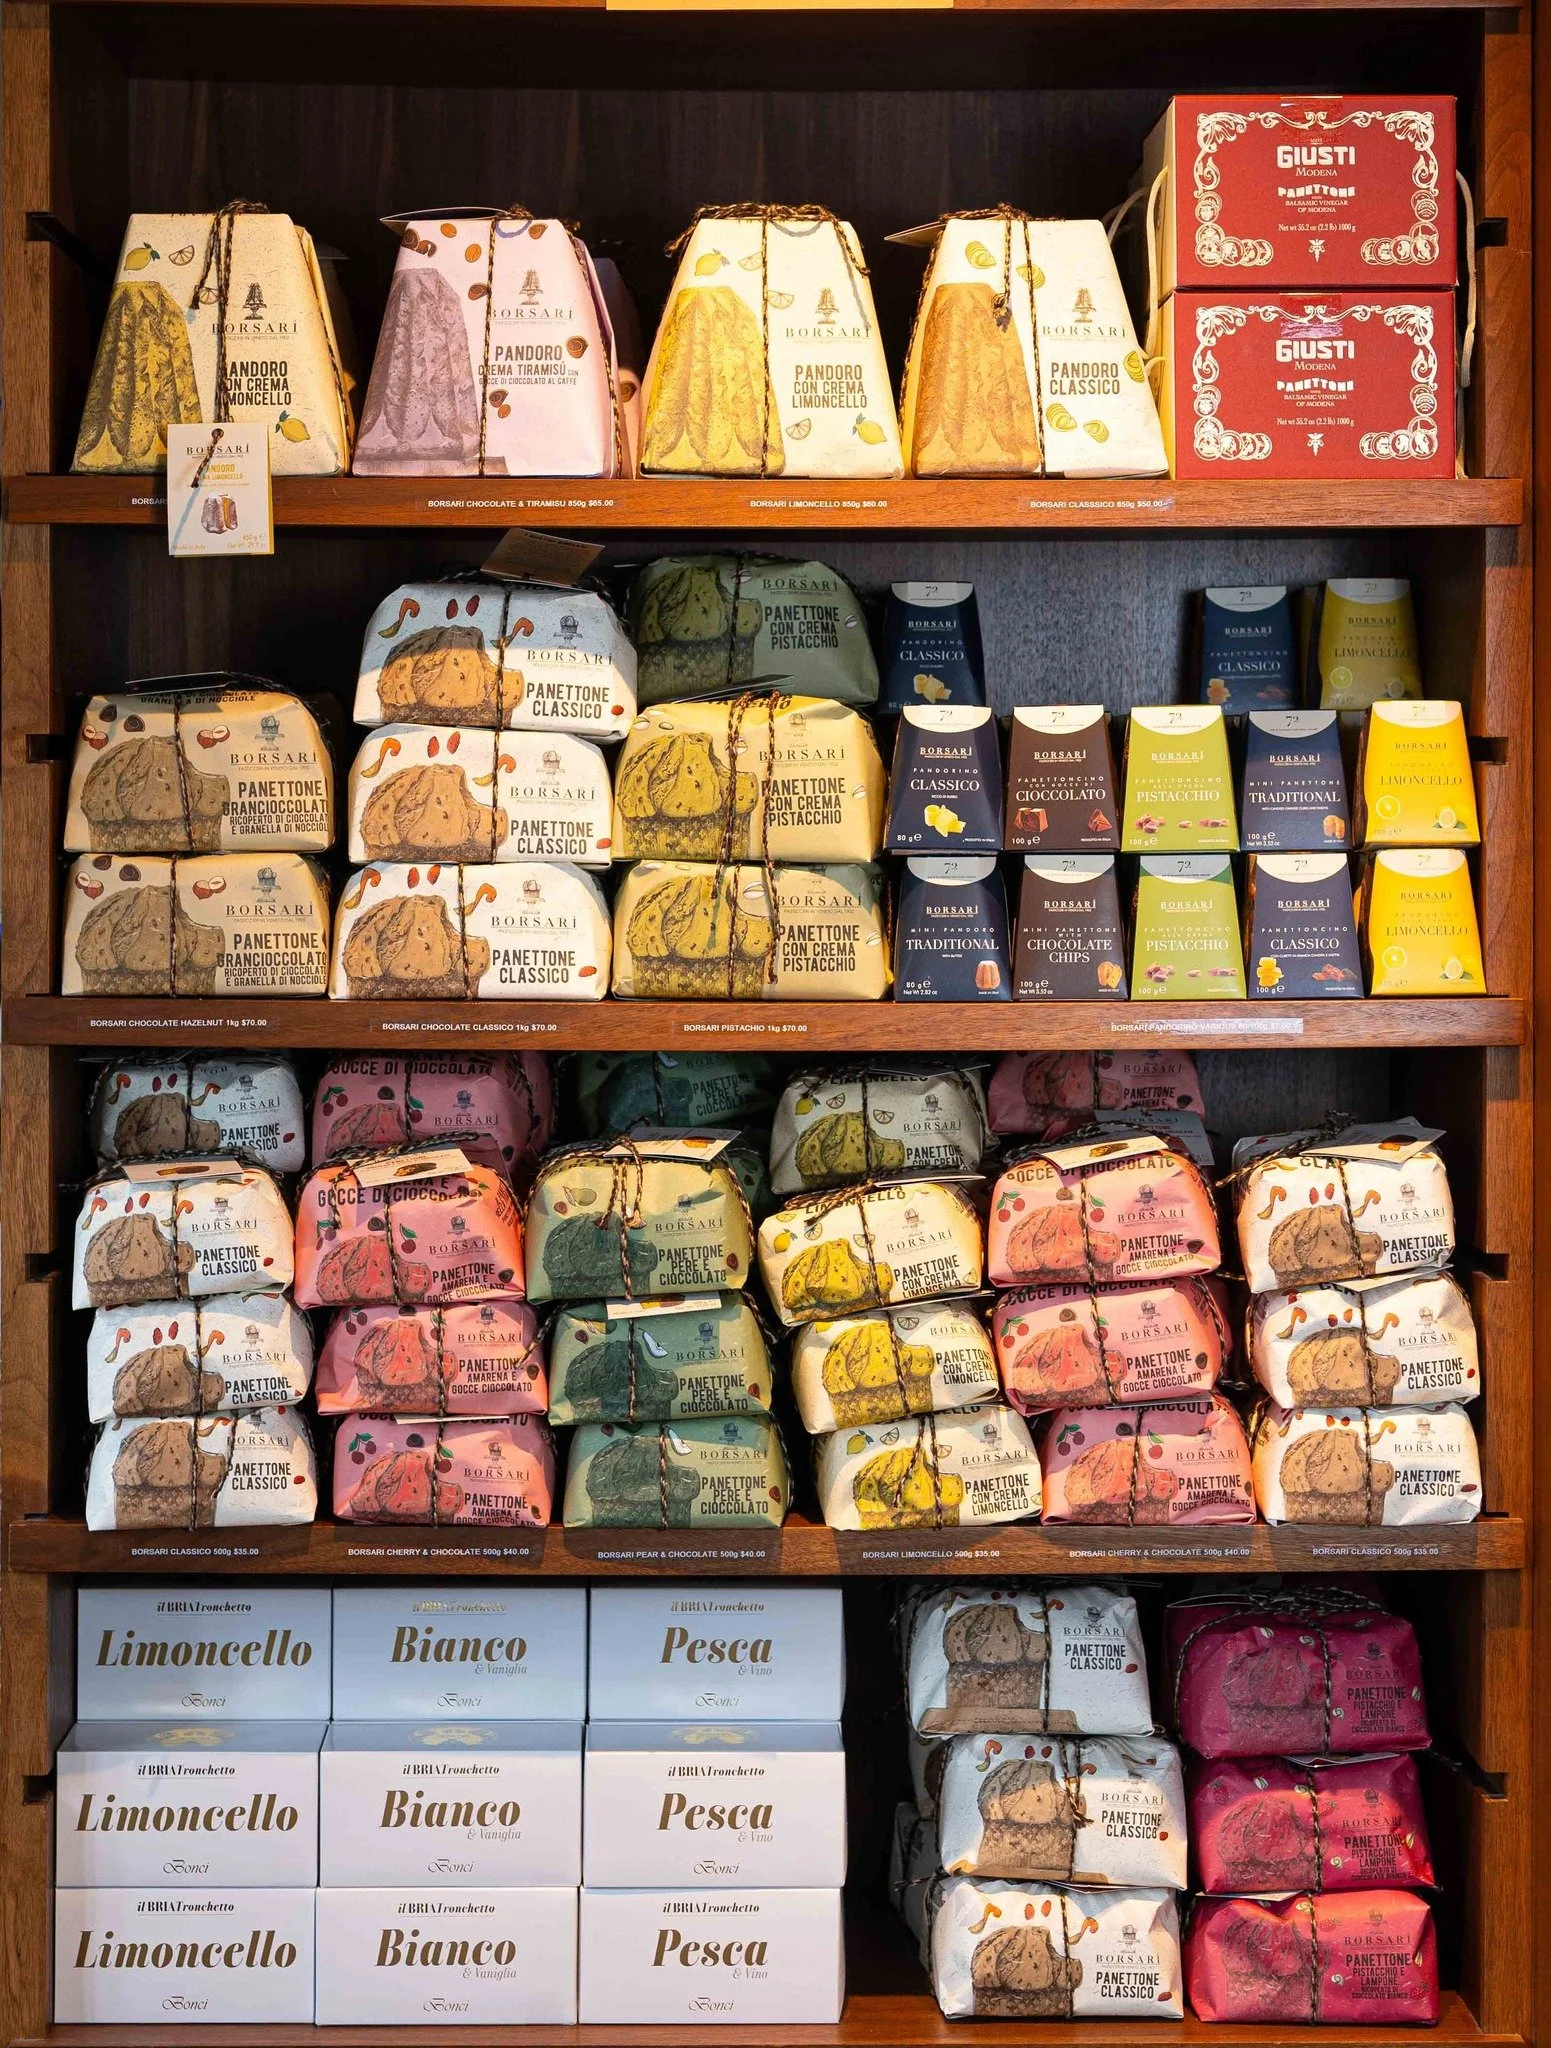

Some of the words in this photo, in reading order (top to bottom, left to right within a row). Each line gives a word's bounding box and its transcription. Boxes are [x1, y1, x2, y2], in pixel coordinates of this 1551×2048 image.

[1277, 145, 1355, 168] GIUSTI
[1278, 183, 1355, 198] PANETTONE
[1338, 223, 1351, 231] 1000
[495, 345, 563, 361] PANDORO
[1275, 339, 1355, 362] GIUSTI
[795, 364, 862, 381] PANDORO
[1051, 362, 1119, 378] PANDORO
[508, 377, 546, 385] CIOCCOLATO
[793, 381, 818, 395] CON
[823, 381, 864, 394] CREMA
[1050, 379, 1120, 395] CLASSICO
[1276, 378, 1355, 392] PANETTONE
[792, 394, 868, 409] LIMONCELLO
[428, 500, 464, 508] BORSARI
[466, 500, 516, 508] CHOCOLATE
[518, 500, 524, 508] &
[526, 500, 566, 508] TIRAMISU
[568, 500, 586, 508] 850g
[588, 500, 614, 508] $65.00
[750, 500, 787, 508] BORSARI
[789, 500, 840, 508] LIMONCELLO
[842, 500, 861, 508] 850g
[862, 500, 888, 508] $60.00
[764, 606, 840, 622] PANETTONE
[770, 622, 794, 635] CON
[799, 621, 837, 634] CREMA
[771, 635, 839, 650] PISTACCHIO
[526, 683, 610, 702] PANETTONE
[533, 700, 602, 719] CLASSICO
[910, 777, 980, 792] CLASSICO
[1016, 788, 1106, 802] CIOCCOLATO
[1136, 789, 1221, 803] PISTACCHIO
[1249, 791, 1341, 804] TRADITIONAL
[511, 820, 594, 837] PANETTONE
[517, 838, 588, 855] CLASSICO
[778, 925, 860, 942] PANETTONE
[233, 932, 319, 951] PANETTONE
[906, 938, 999, 951] TRADITIONAL
[1027, 938, 1112, 951] CHOCOLATE
[1146, 938, 1229, 951] PISTACCHIO
[1270, 937, 1340, 950] CLASSICO
[782, 943, 807, 957] CON
[812, 942, 856, 957] CREMA
[1049, 951, 1090, 963] CHIPS
[493, 949, 576, 966] PANETTONE
[783, 956, 856, 972] PISTACCHIO
[500, 967, 570, 984] CLASSICO
[90, 1019, 127, 1027] BORSARI
[129, 1019, 178, 1027] CHOCOLATE
[181, 1019, 223, 1027] HAZELNUT
[226, 1019, 239, 1027] 1kg
[241, 1019, 267, 1027] $70.00
[382, 1023, 419, 1031] BORSARI
[421, 1023, 470, 1031] CHOCOLATE
[472, 1023, 514, 1031] CLASSICO
[515, 1023, 529, 1031] 1kg
[531, 1023, 557, 1031] $70.00
[684, 1024, 720, 1032] BORSARI
[721, 1024, 765, 1032] PISTACHIO
[767, 1024, 780, 1032] 1kg
[782, 1024, 807, 1032] $70.00
[196, 1245, 261, 1264] PANETTONE
[659, 1244, 724, 1262] PANETTONE
[202, 1259, 257, 1276] CLASSICO
[671, 1260, 698, 1274] PERE
[703, 1259, 710, 1271] E
[660, 1269, 727, 1286] CIOCCOLATO
[1126, 1349, 1192, 1369] PANETTONE
[1137, 1369, 1178, 1380] AMARENA
[1401, 1357, 1465, 1377] PANETTONE
[1123, 1380, 1150, 1393] GOCCE
[1152, 1373, 1203, 1389] CIOCCOLATO
[1408, 1372, 1462, 1390] CLASSICO
[965, 1473, 1030, 1494] PANETTONE
[972, 1492, 991, 1504] CON
[993, 1490, 1027, 1503] CREMA
[972, 1500, 1029, 1516] LIMONCELLO
[131, 1548, 168, 1556] BORSARI
[170, 1548, 211, 1556] CLASSICO
[213, 1548, 231, 1556] 500g
[233, 1548, 259, 1556] $35.00
[598, 1551, 634, 1559] BORSARI
[636, 1551, 659, 1559] PEAR
[660, 1551, 666, 1559] &
[668, 1551, 718, 1559] CHOCOLATE
[720, 1551, 738, 1559] 500g
[740, 1551, 765, 1559] $40.00
[863, 1551, 899, 1559] BORSARI
[901, 1551, 953, 1559] LIMONCELLO
[954, 1551, 973, 1559] 500g
[975, 1551, 1000, 1559] $35.00
[1313, 1548, 1349, 1556] BORSARI
[1351, 1548, 1391, 1556] CLASSICO
[1393, 1548, 1411, 1556] 500g
[1413, 1548, 1439, 1556] $35.00
[96, 1630, 313, 1667] Limoncello
[390, 1626, 527, 1662] Bianco
[660, 1627, 773, 1663] Pesca
[1065, 1643, 1126, 1657] PANETTONE
[1070, 1658, 1122, 1670] CLASSICO
[181, 1693, 227, 1708] Bonci
[436, 1693, 482, 1708] Bonci
[695, 1692, 740, 1707] Bonci
[75, 1793, 298, 1832] Limoncello
[379, 1789, 521, 1828] Bianco
[657, 1792, 773, 1830] Pesca
[163, 1859, 209, 1874] Bonci
[428, 1858, 475, 1873] Bonci
[693, 1860, 740, 1875] Bonci
[73, 1930, 297, 1968] Limoncello
[374, 1928, 517, 1967] Bianco
[651, 1928, 768, 1967] Pesca
[1346, 1953, 1411, 1967] PANETTONE
[1096, 1971, 1159, 1985] PANETTONE
[1353, 1967, 1398, 1977] PISTACCHIO
[1360, 1977, 1398, 1986] LAMPONE
[1101, 1985, 1155, 1999] CLASSICO
[162, 1996, 208, 2010] Bonci
[423, 1997, 469, 2012] Bonci
[688, 1997, 734, 2012] Bonci
